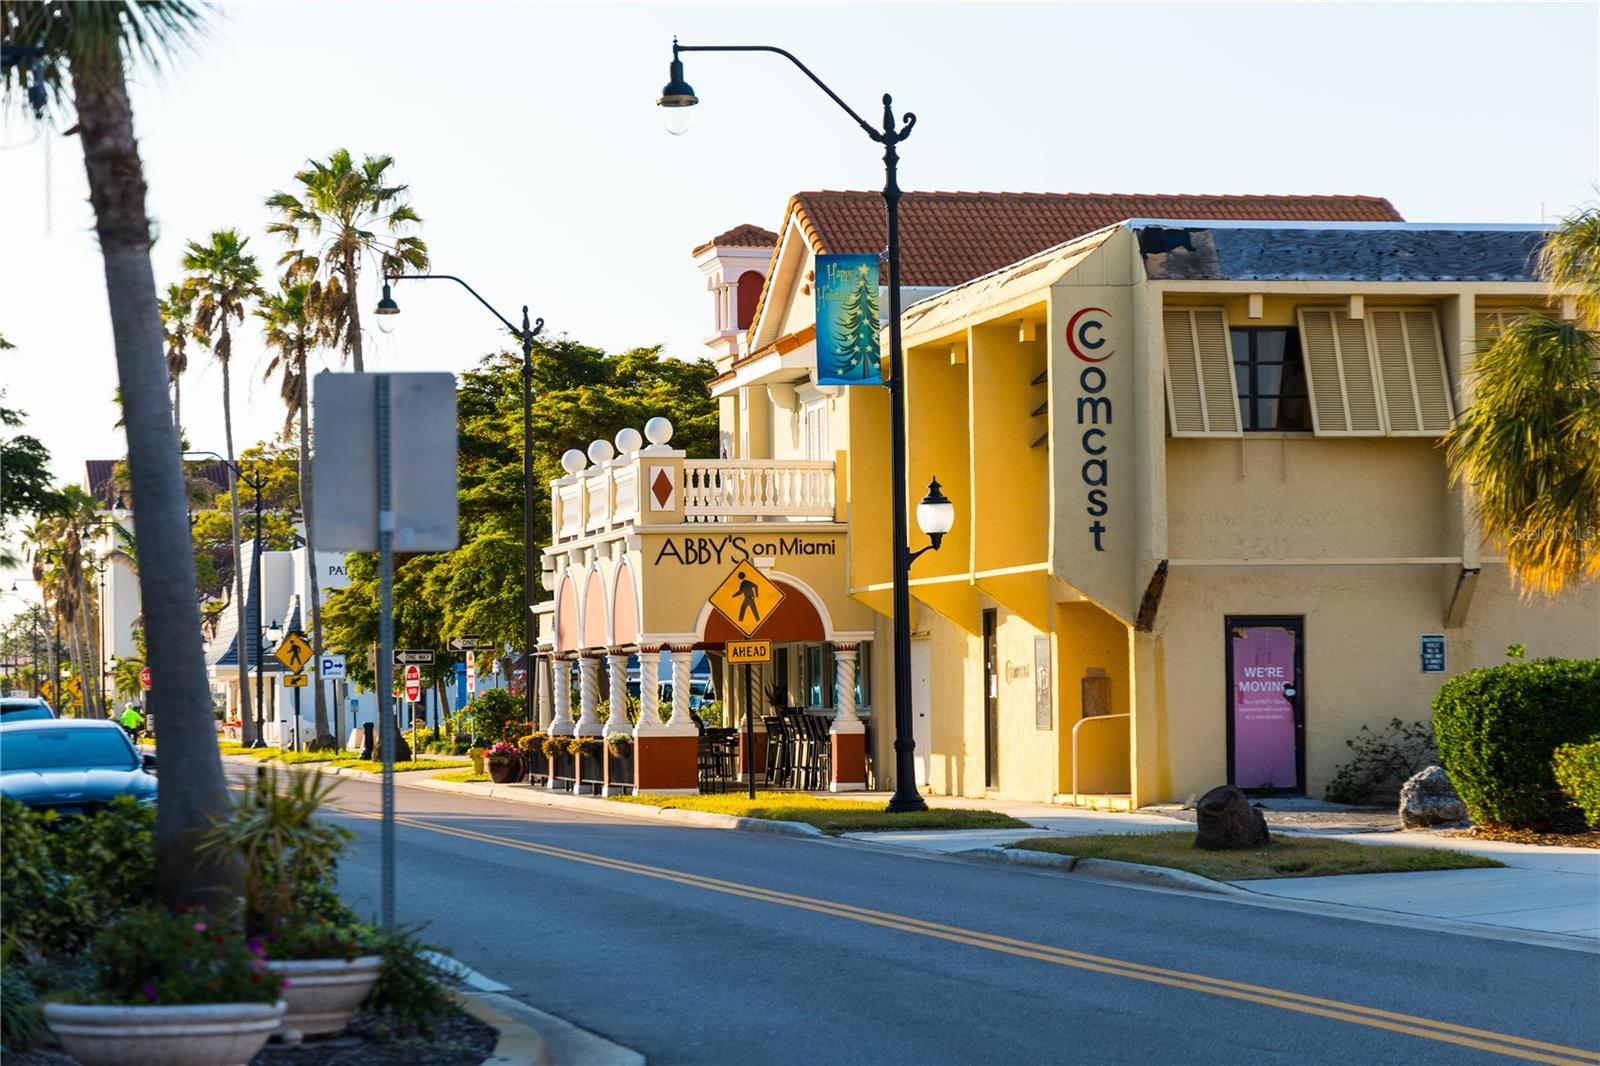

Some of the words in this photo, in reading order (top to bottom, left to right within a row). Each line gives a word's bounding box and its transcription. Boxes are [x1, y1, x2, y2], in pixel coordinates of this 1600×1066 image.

[1066, 307, 1116, 552] Comcast
[655, 535, 749, 565] ABBY'S
[752, 543, 776, 555] on
[779, 538, 836, 555] Miami
[732, 645, 767, 658] AHEAD
[1244, 667, 1285, 678] WE'RE
